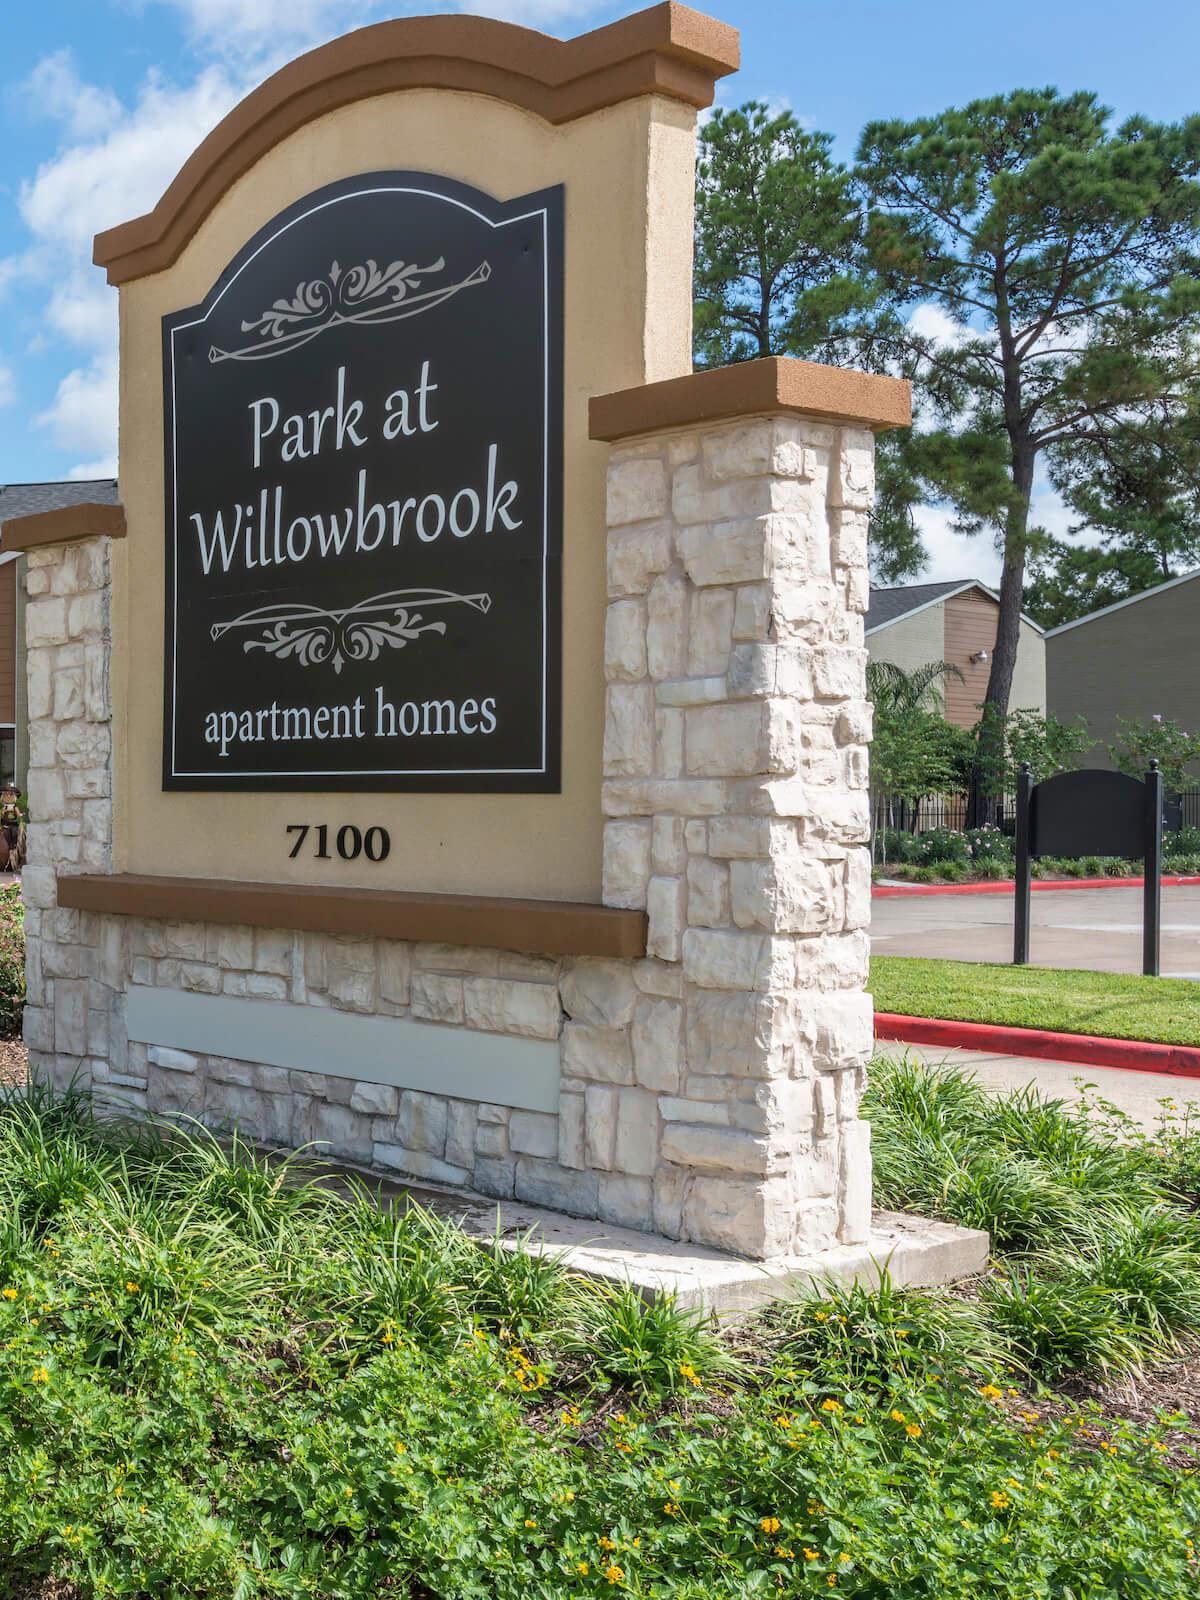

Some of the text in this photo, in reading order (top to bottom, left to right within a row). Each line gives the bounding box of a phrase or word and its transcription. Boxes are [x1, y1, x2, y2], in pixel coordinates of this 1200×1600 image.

[248, 360, 439, 468] Park at
[190, 443, 523, 575] Willowbrook
[204, 686, 497, 757] apartment homes
[285, 824, 391, 862] 7100
